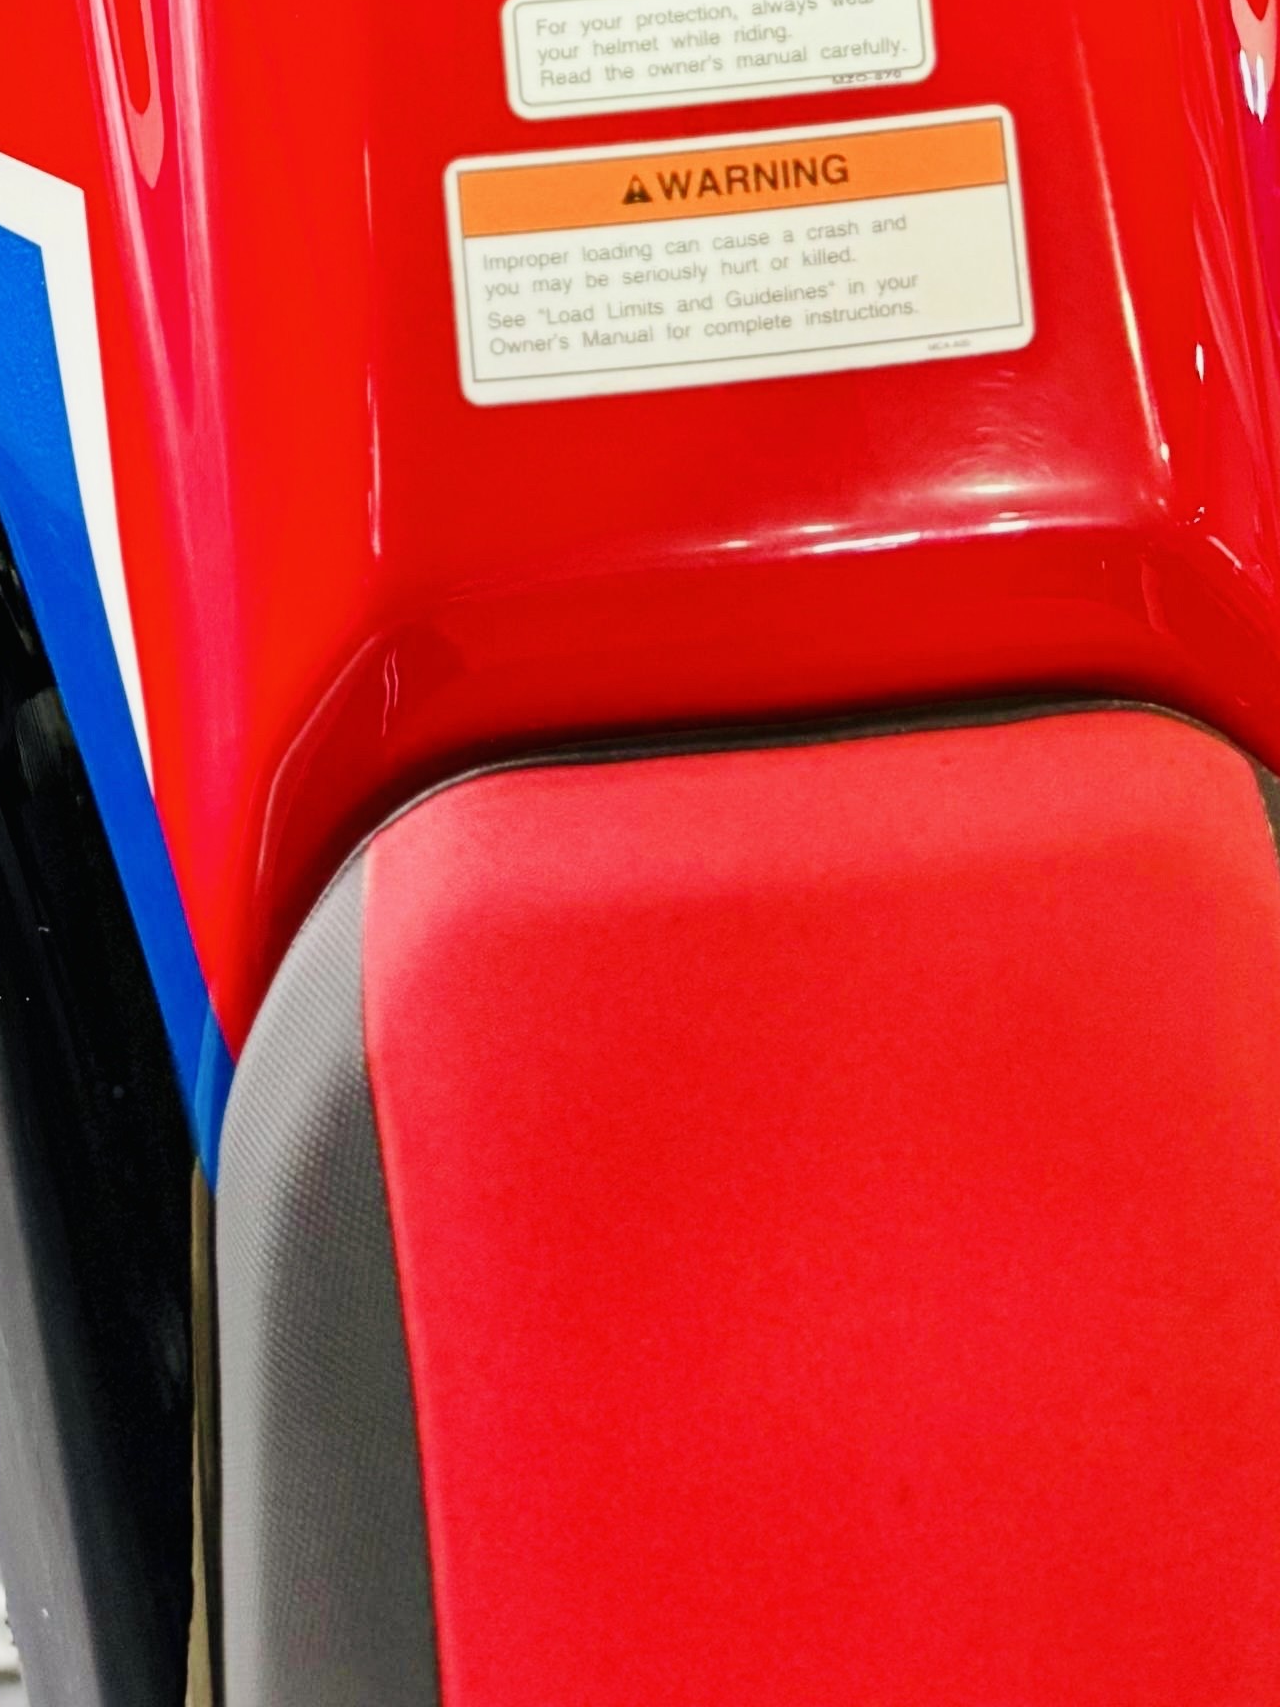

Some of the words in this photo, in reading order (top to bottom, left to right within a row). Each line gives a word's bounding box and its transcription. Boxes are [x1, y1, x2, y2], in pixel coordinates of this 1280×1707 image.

[536, 18, 567, 36] For
[581, 15, 623, 36] your
[635, 3, 738, 31] protection,
[537, 44, 580, 66] your
[593, 36, 659, 57] helmet
[672, 30, 721, 50] while
[734, 24, 793, 44] riding.
[540, 66, 591, 87] Read
[605, 63, 635, 81] the
[648, 55, 724, 78] owner's
[736, 46, 808, 69] manual
[820, 37, 907, 60] carefully.
[657, 153, 849, 200] WARNING
[483, 250, 570, 273] Improper
[582, 242, 653, 263] loading
[665, 238, 700, 256] can
[712, 230, 770, 251] cause
[783, 229, 795, 243] a
[806, 220, 860, 241] crash
[871, 214, 908, 235] and
[485, 280, 520, 302] you
[532, 276, 573, 296] may
[585, 269, 610, 289] be
[622, 261, 709, 286] seriously
[720, 258, 759, 276] hurt
[770, 256, 790, 272] or
[802, 246, 858, 267] killed.
[488, 311, 527, 330] See
[607, 300, 665, 321] Limits
[677, 293, 714, 314] and
[848, 277, 866, 296] in
[876, 273, 920, 297] your
[489, 333, 570, 356] Owner's
[582, 325, 654, 348] Manual
[666, 322, 692, 340] for
[704, 314, 793, 338] complete
[805, 299, 919, 326] instructions.
